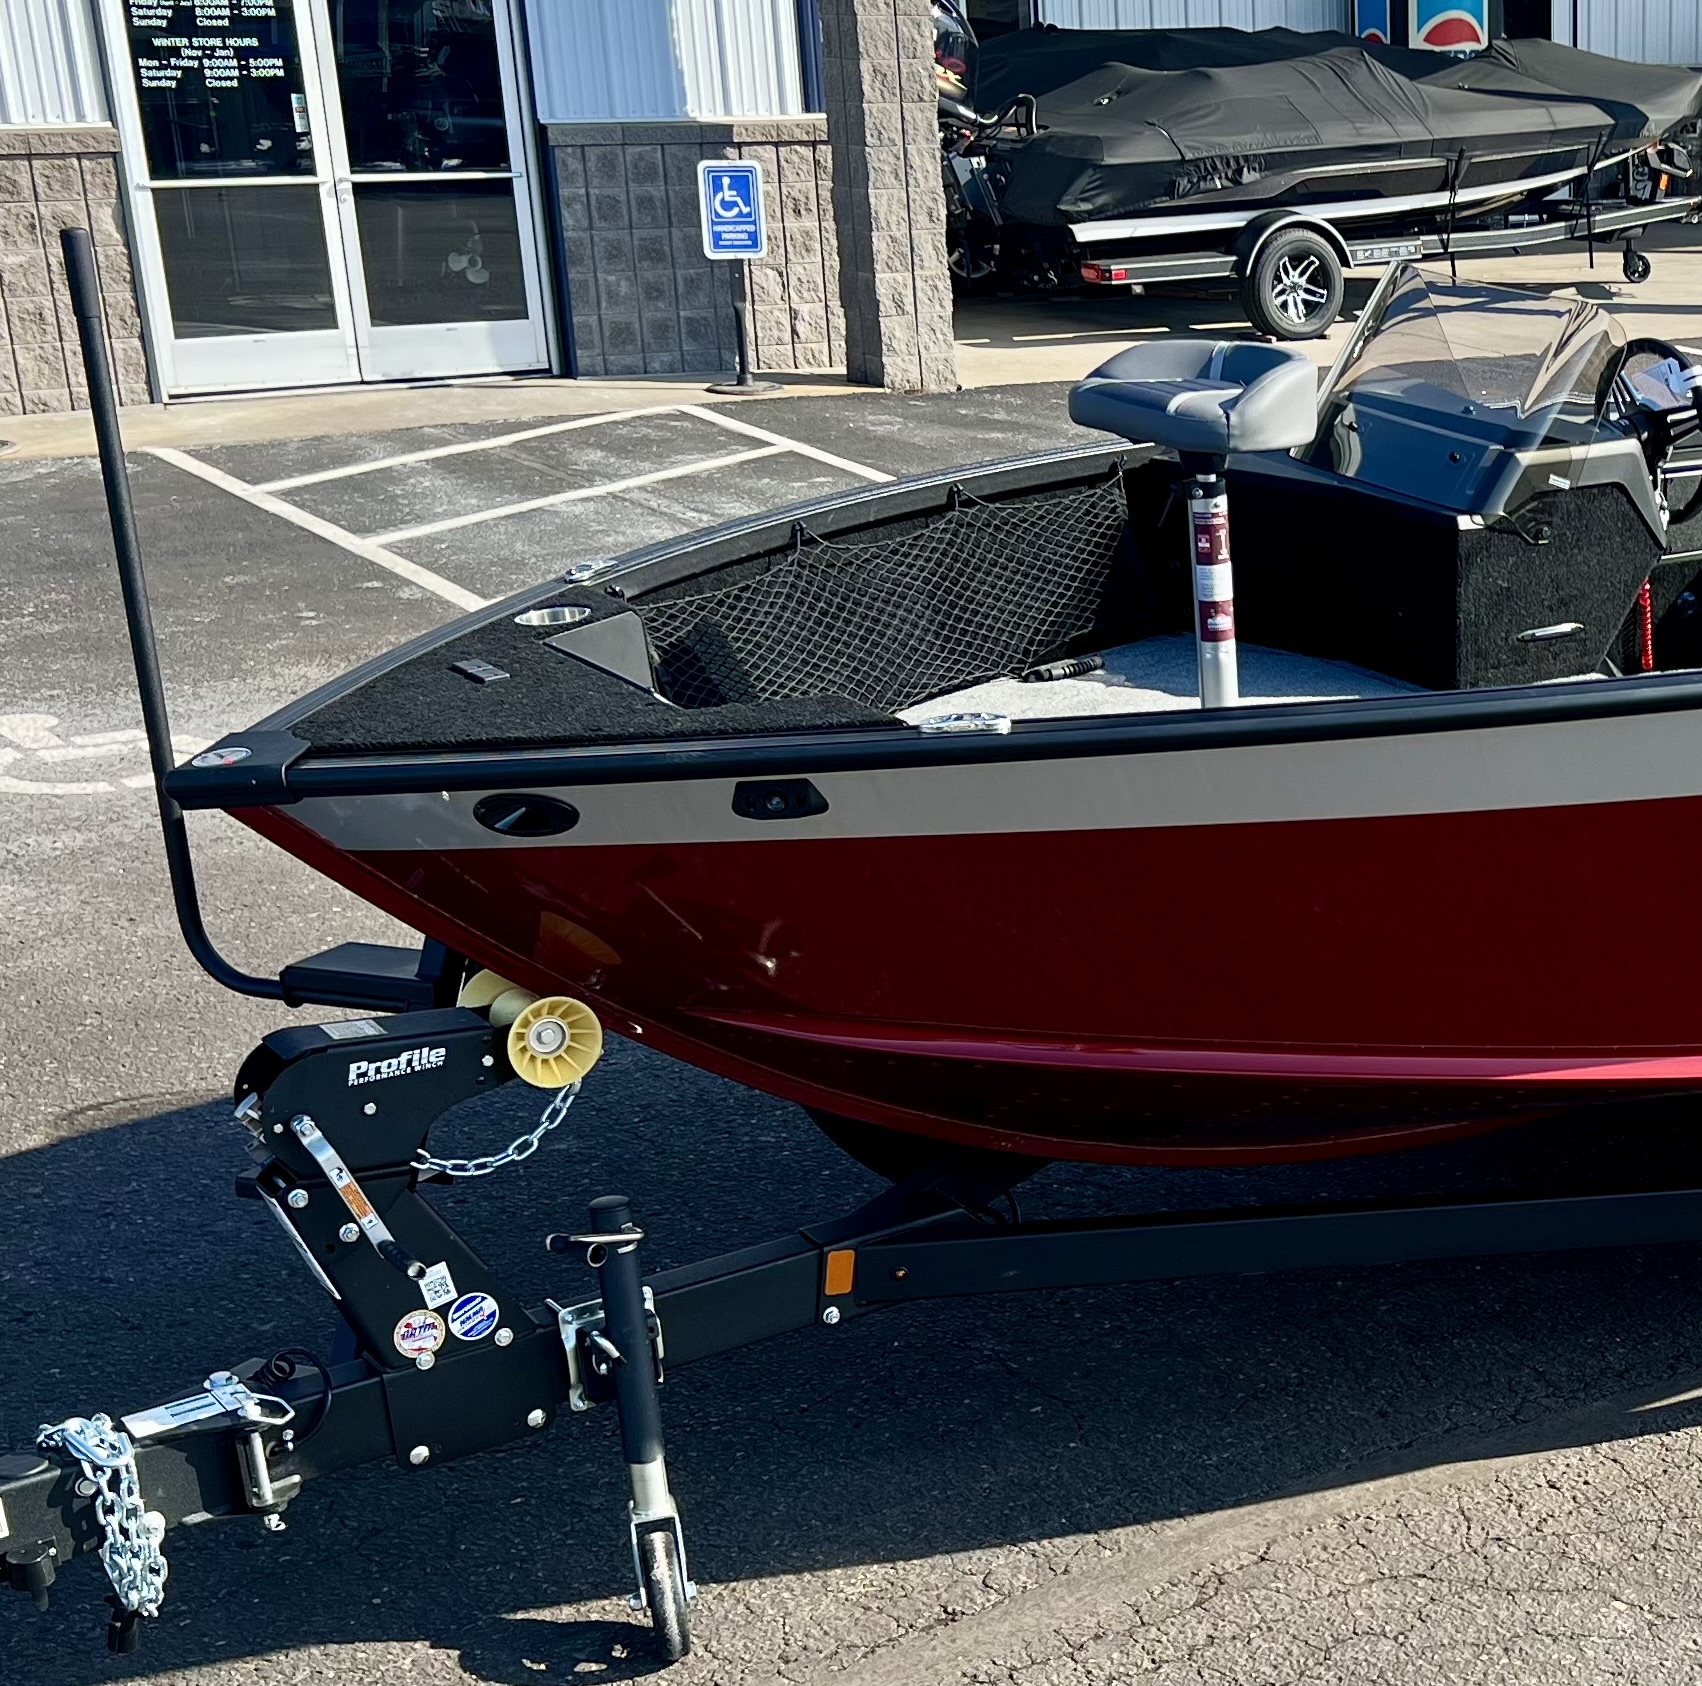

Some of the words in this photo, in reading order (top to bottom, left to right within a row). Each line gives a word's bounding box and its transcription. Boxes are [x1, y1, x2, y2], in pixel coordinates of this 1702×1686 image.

[131, 7, 172, 17] Saturday
[195, 7, 230, 16] 8:00AM
[241, 7, 276, 16] 3:00PM
[132, 18, 167, 27] Sunday
[196, 18, 229, 26] Closed
[152, 37, 189, 46] WINTER
[192, 37, 223, 47] STORE
[225, 37, 259, 47] HOURS
[181, 47, 202, 57] (Nov
[213, 47, 234, 57] Jan)
[138, 58, 159, 67] Mon
[170, 58, 198, 68] Friday
[202, 58, 238, 67] 9:00AM
[249, 58, 283, 67] 5:00PM
[140, 68, 182, 78] Saturday
[204, 68, 239, 77] 9:00AM
[250, 68, 285, 77] 3:00PM
[142, 78, 177, 88] Sunday
[205, 78, 238, 87] Closed
[349, 1047, 446, 1080] Profile
[348, 1067, 411, 1086] PERFORMANCE
[415, 1060, 443, 1072] WINCH
